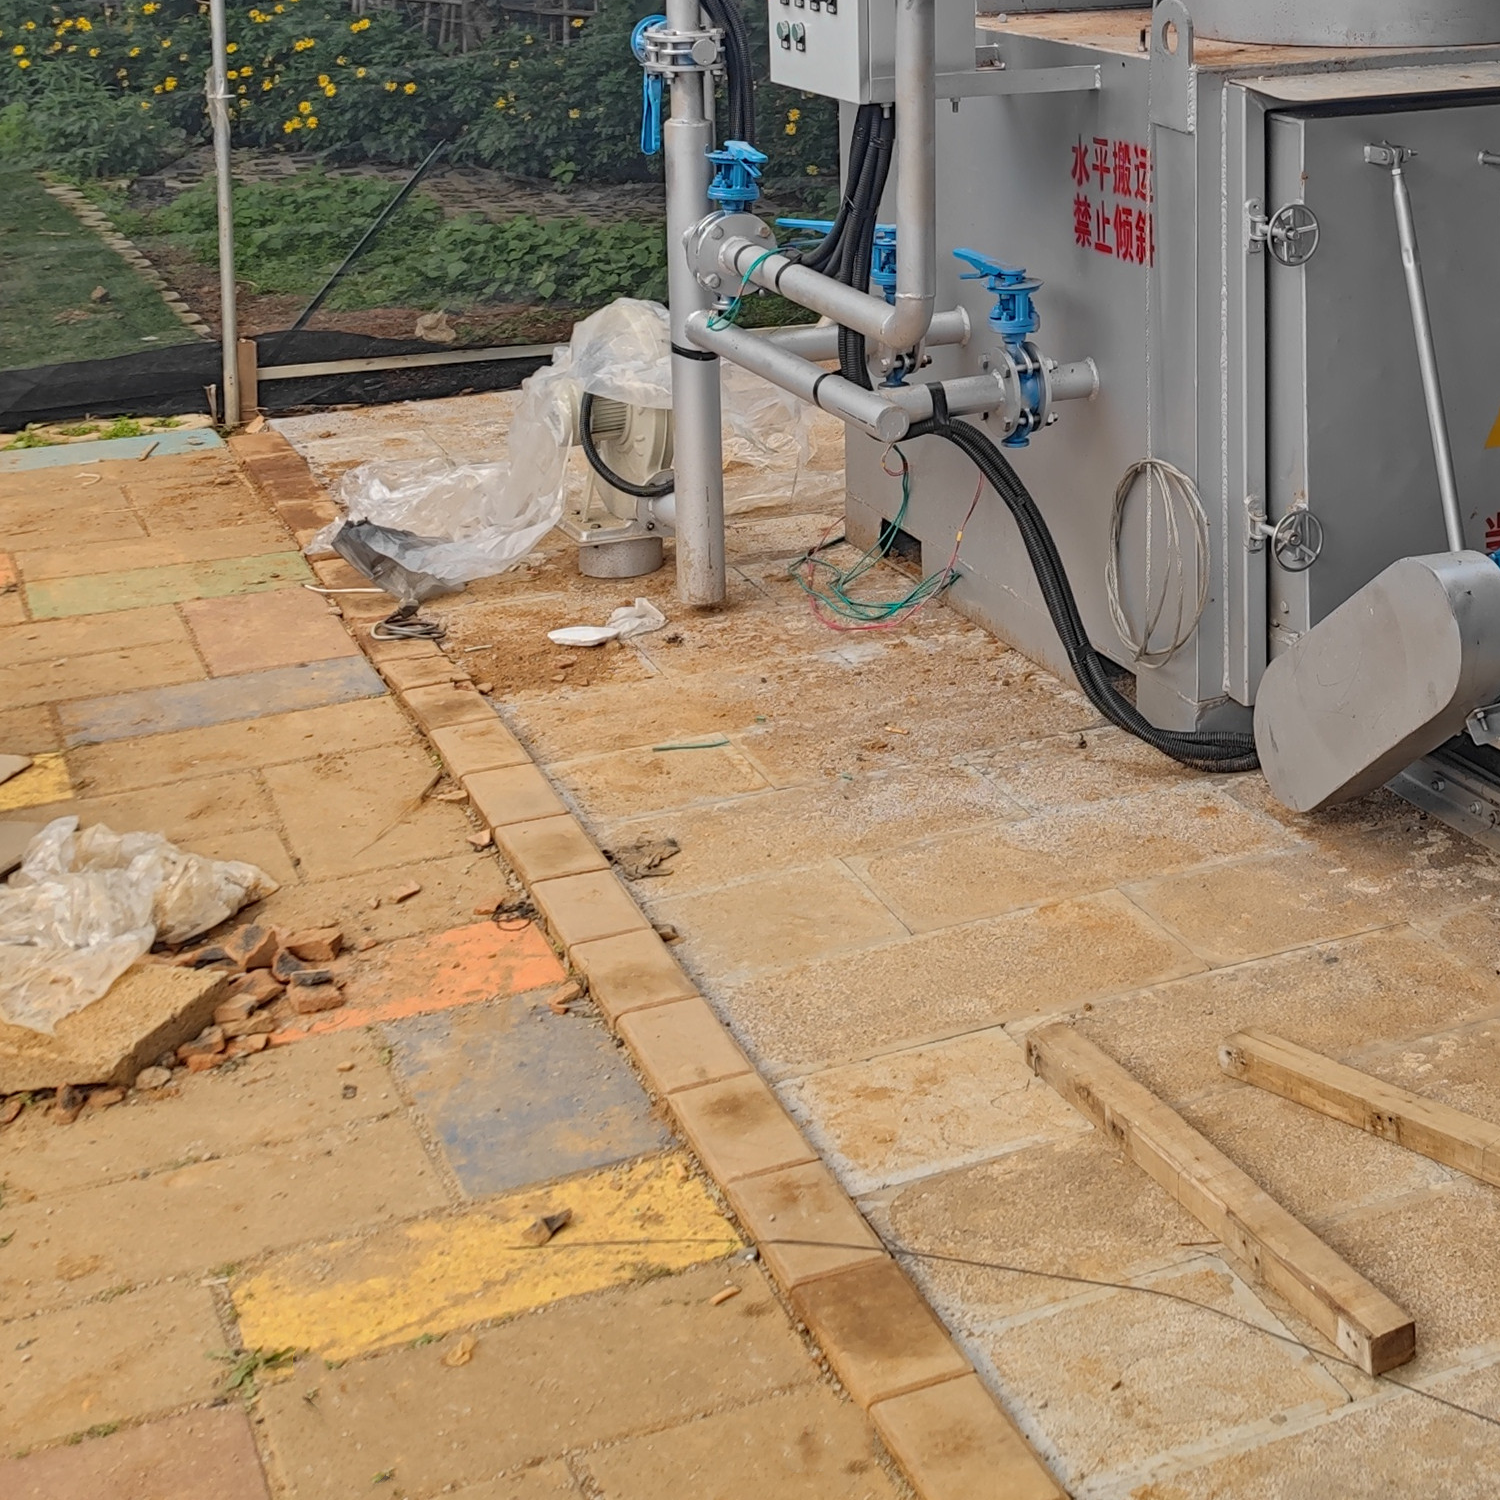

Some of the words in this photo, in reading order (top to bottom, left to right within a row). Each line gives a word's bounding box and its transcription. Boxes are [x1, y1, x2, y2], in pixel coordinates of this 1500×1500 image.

[1070, 133, 1154, 203] 水平搬运
[1073, 192, 1155, 269] 禁止倾斜
